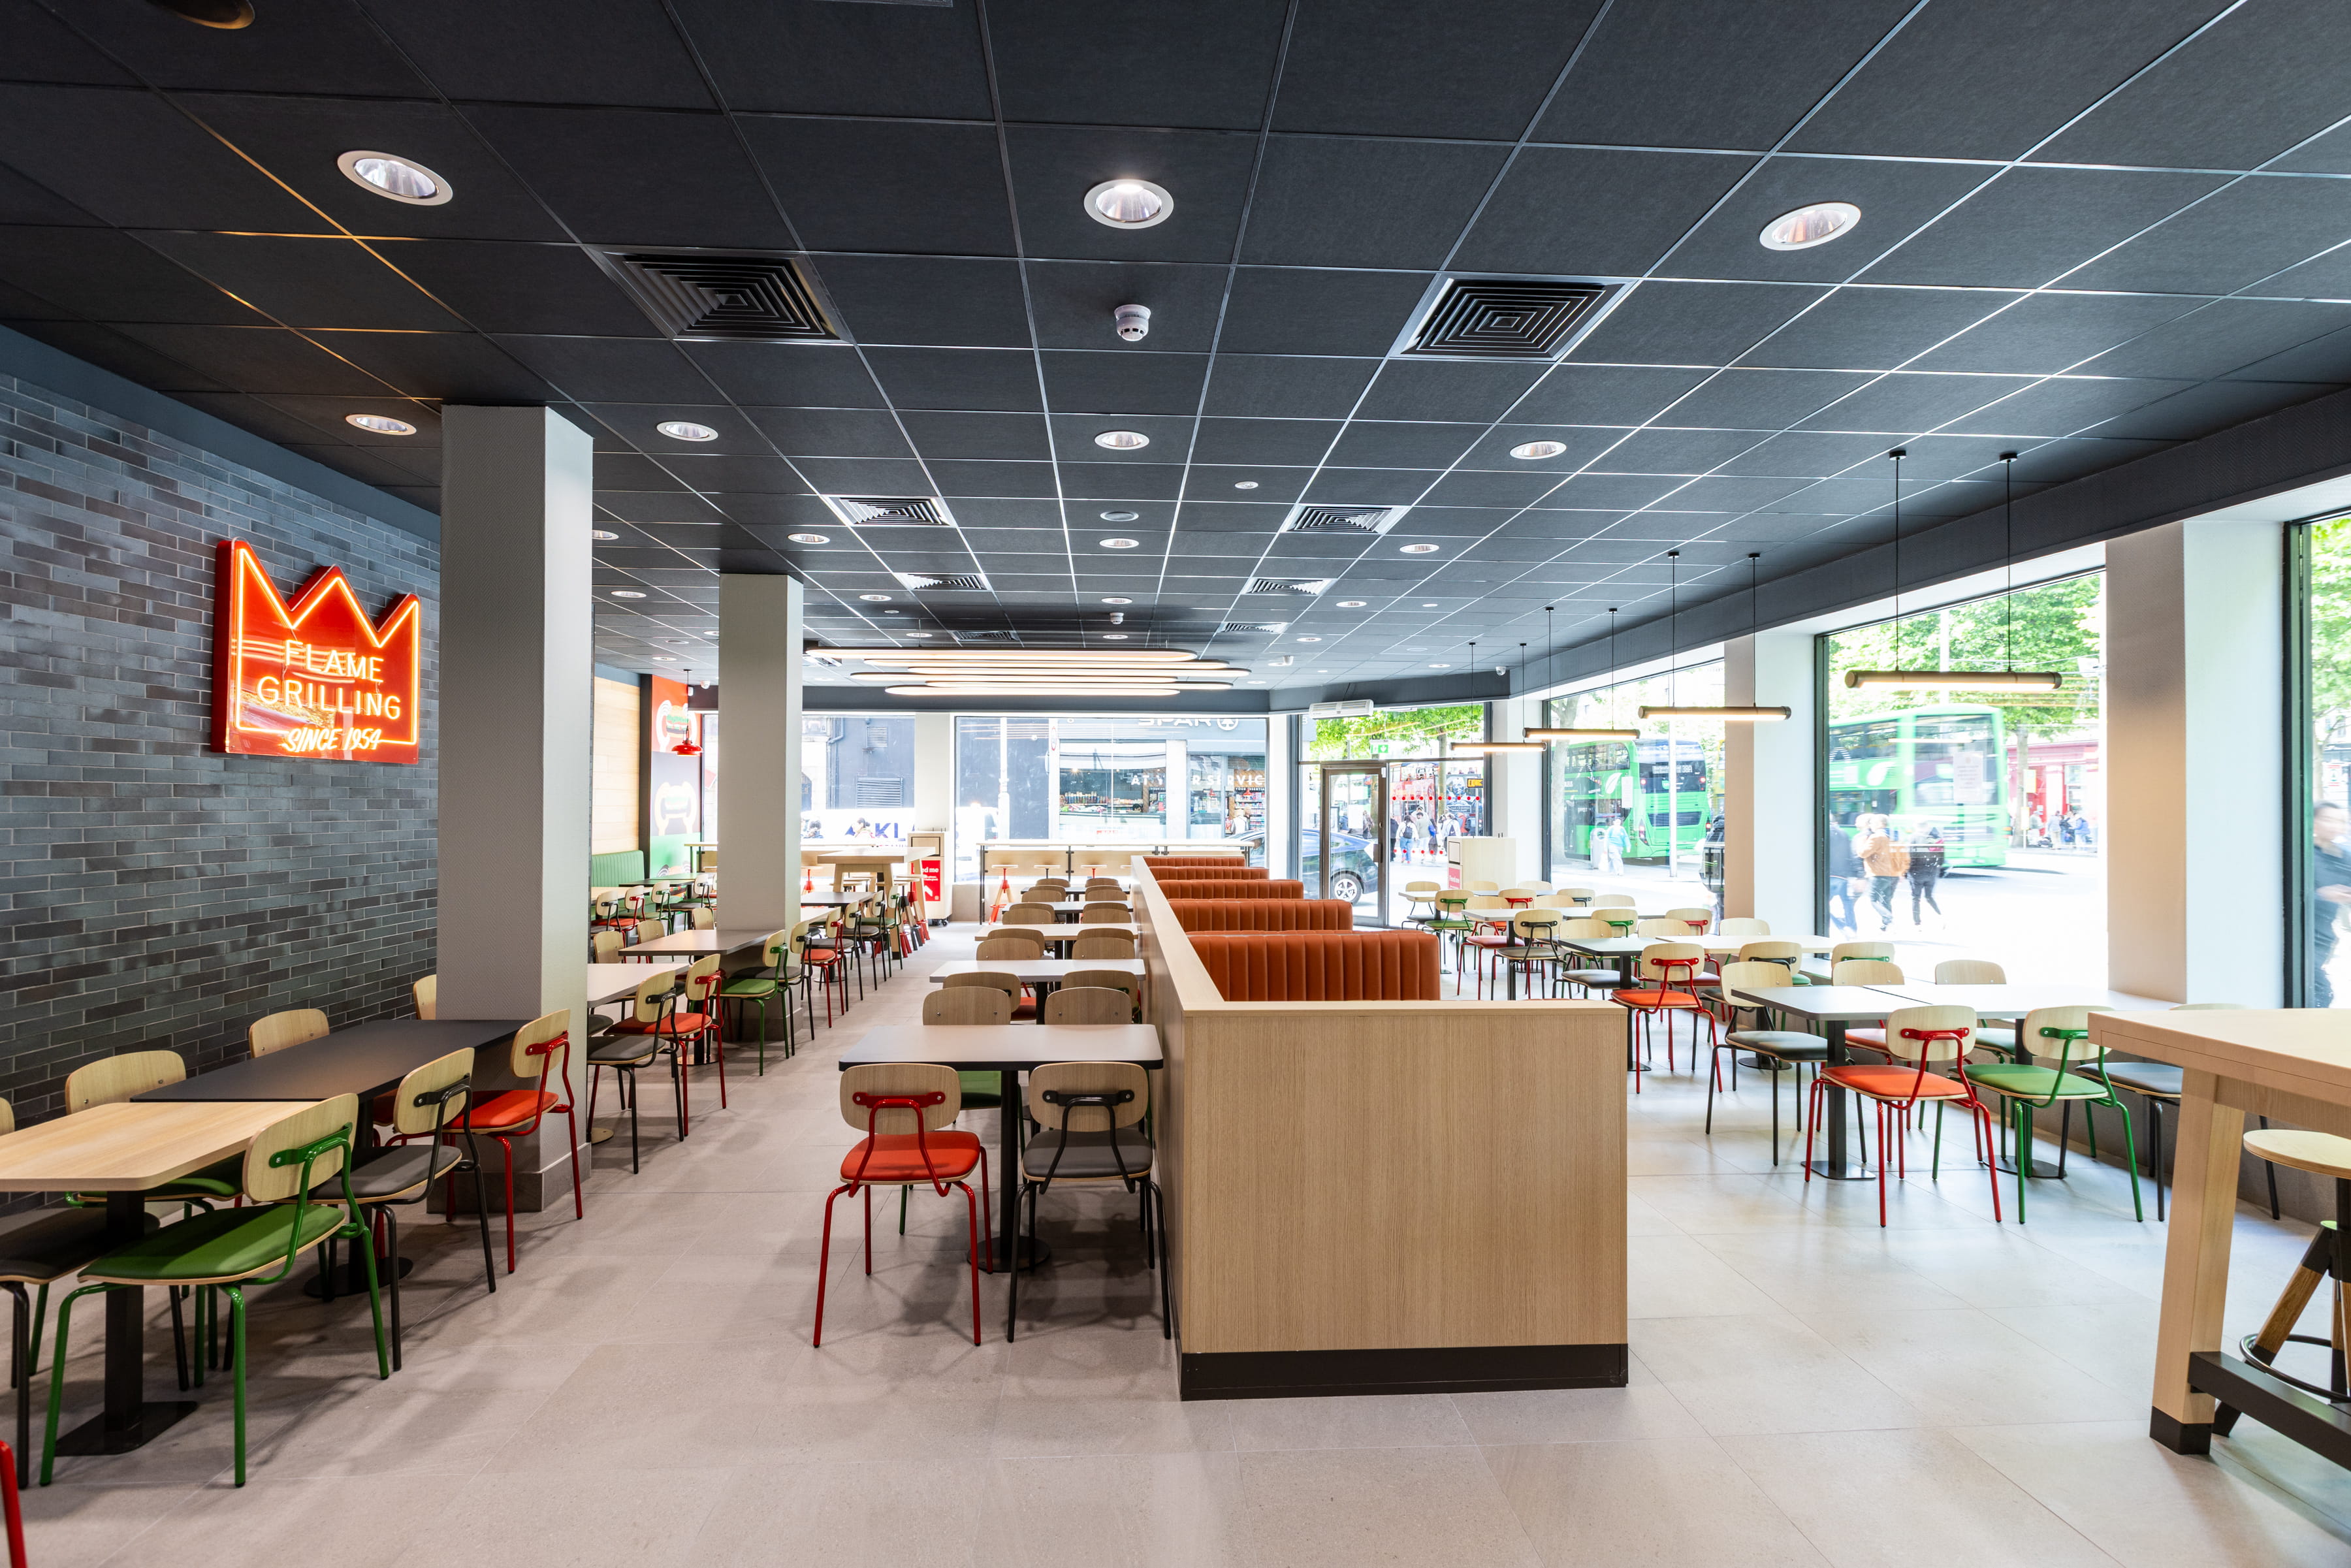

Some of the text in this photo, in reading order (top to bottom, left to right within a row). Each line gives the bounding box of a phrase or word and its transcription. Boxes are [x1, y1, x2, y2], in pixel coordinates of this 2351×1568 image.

[285, 639, 384, 683] FLAME
[257, 676, 401, 720] GRILLING
[283, 727, 382, 752] SINCE 1954
[1131, 775, 1149, 785] AT
[1207, 775, 1263, 786] SERVIC
